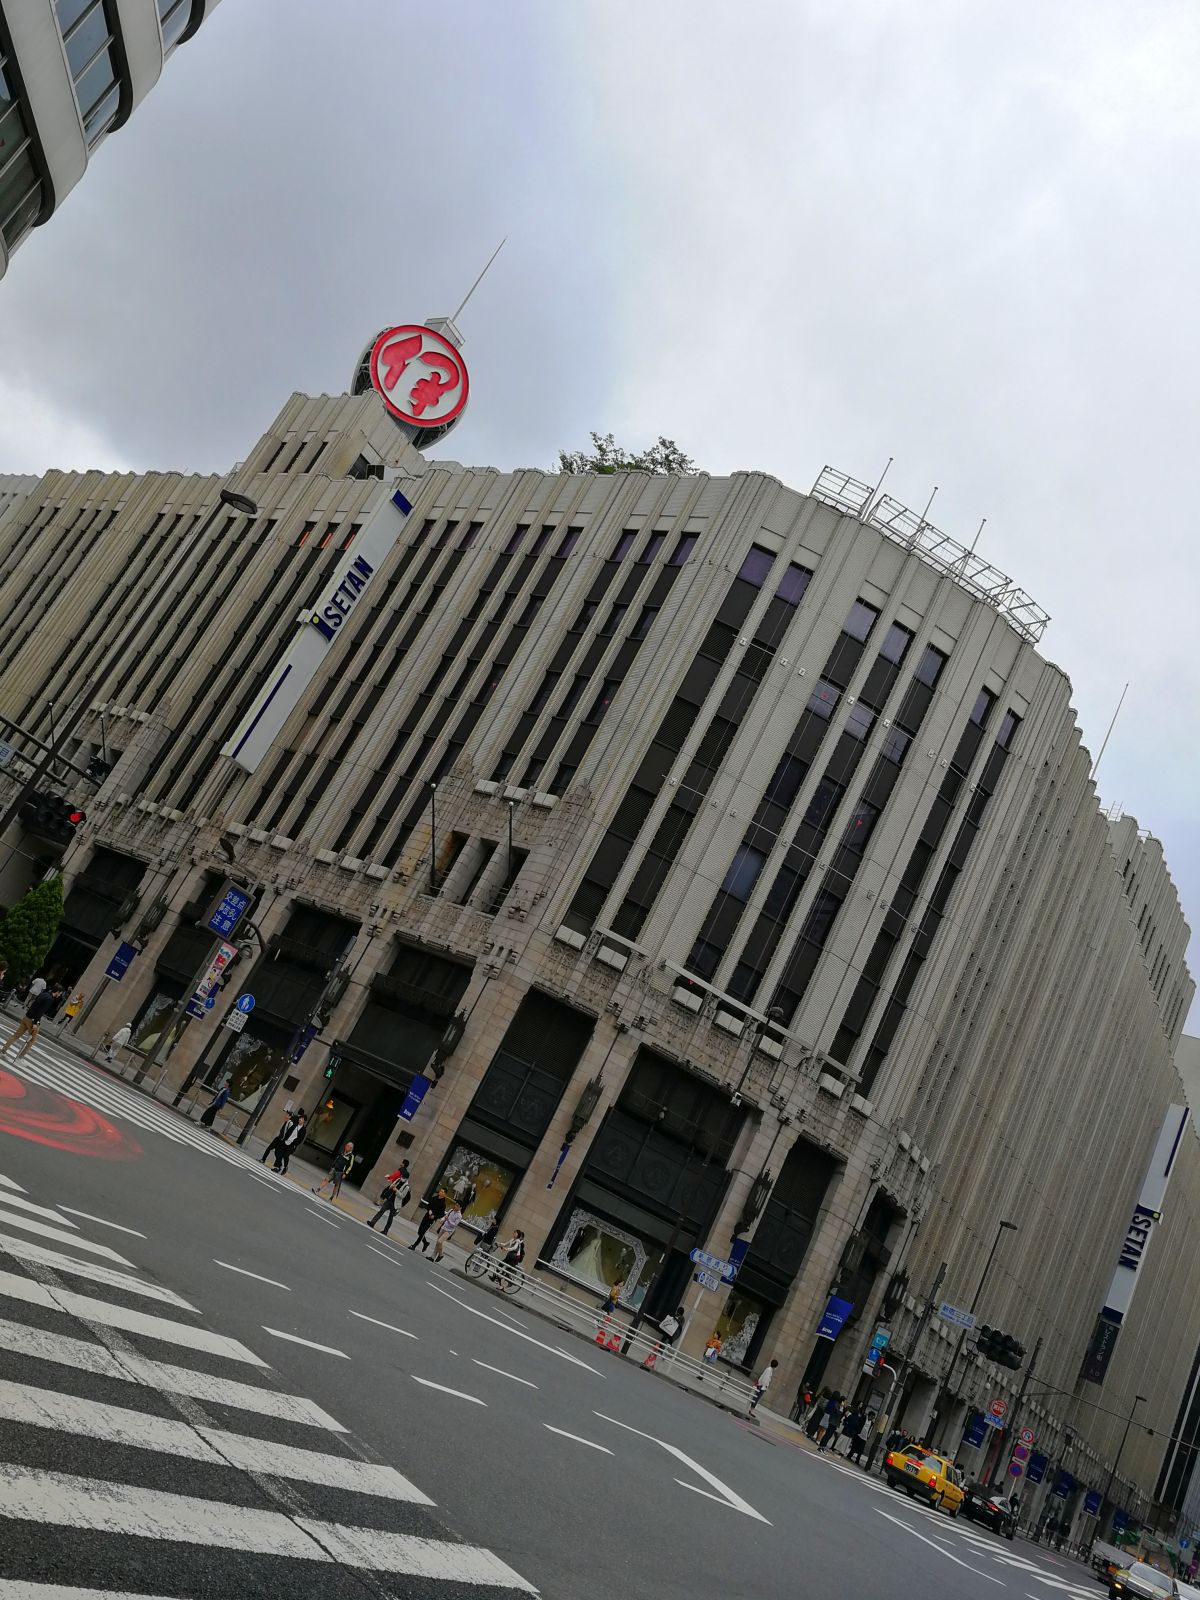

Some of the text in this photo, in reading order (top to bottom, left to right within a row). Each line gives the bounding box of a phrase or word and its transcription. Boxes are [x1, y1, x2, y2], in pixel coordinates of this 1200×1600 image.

[309, 554, 374, 643] ISETAN
[211, 912, 232, 932] 注意
[224, 891, 247, 911] 交差点
[1118, 1203, 1161, 1272] ISETAN
